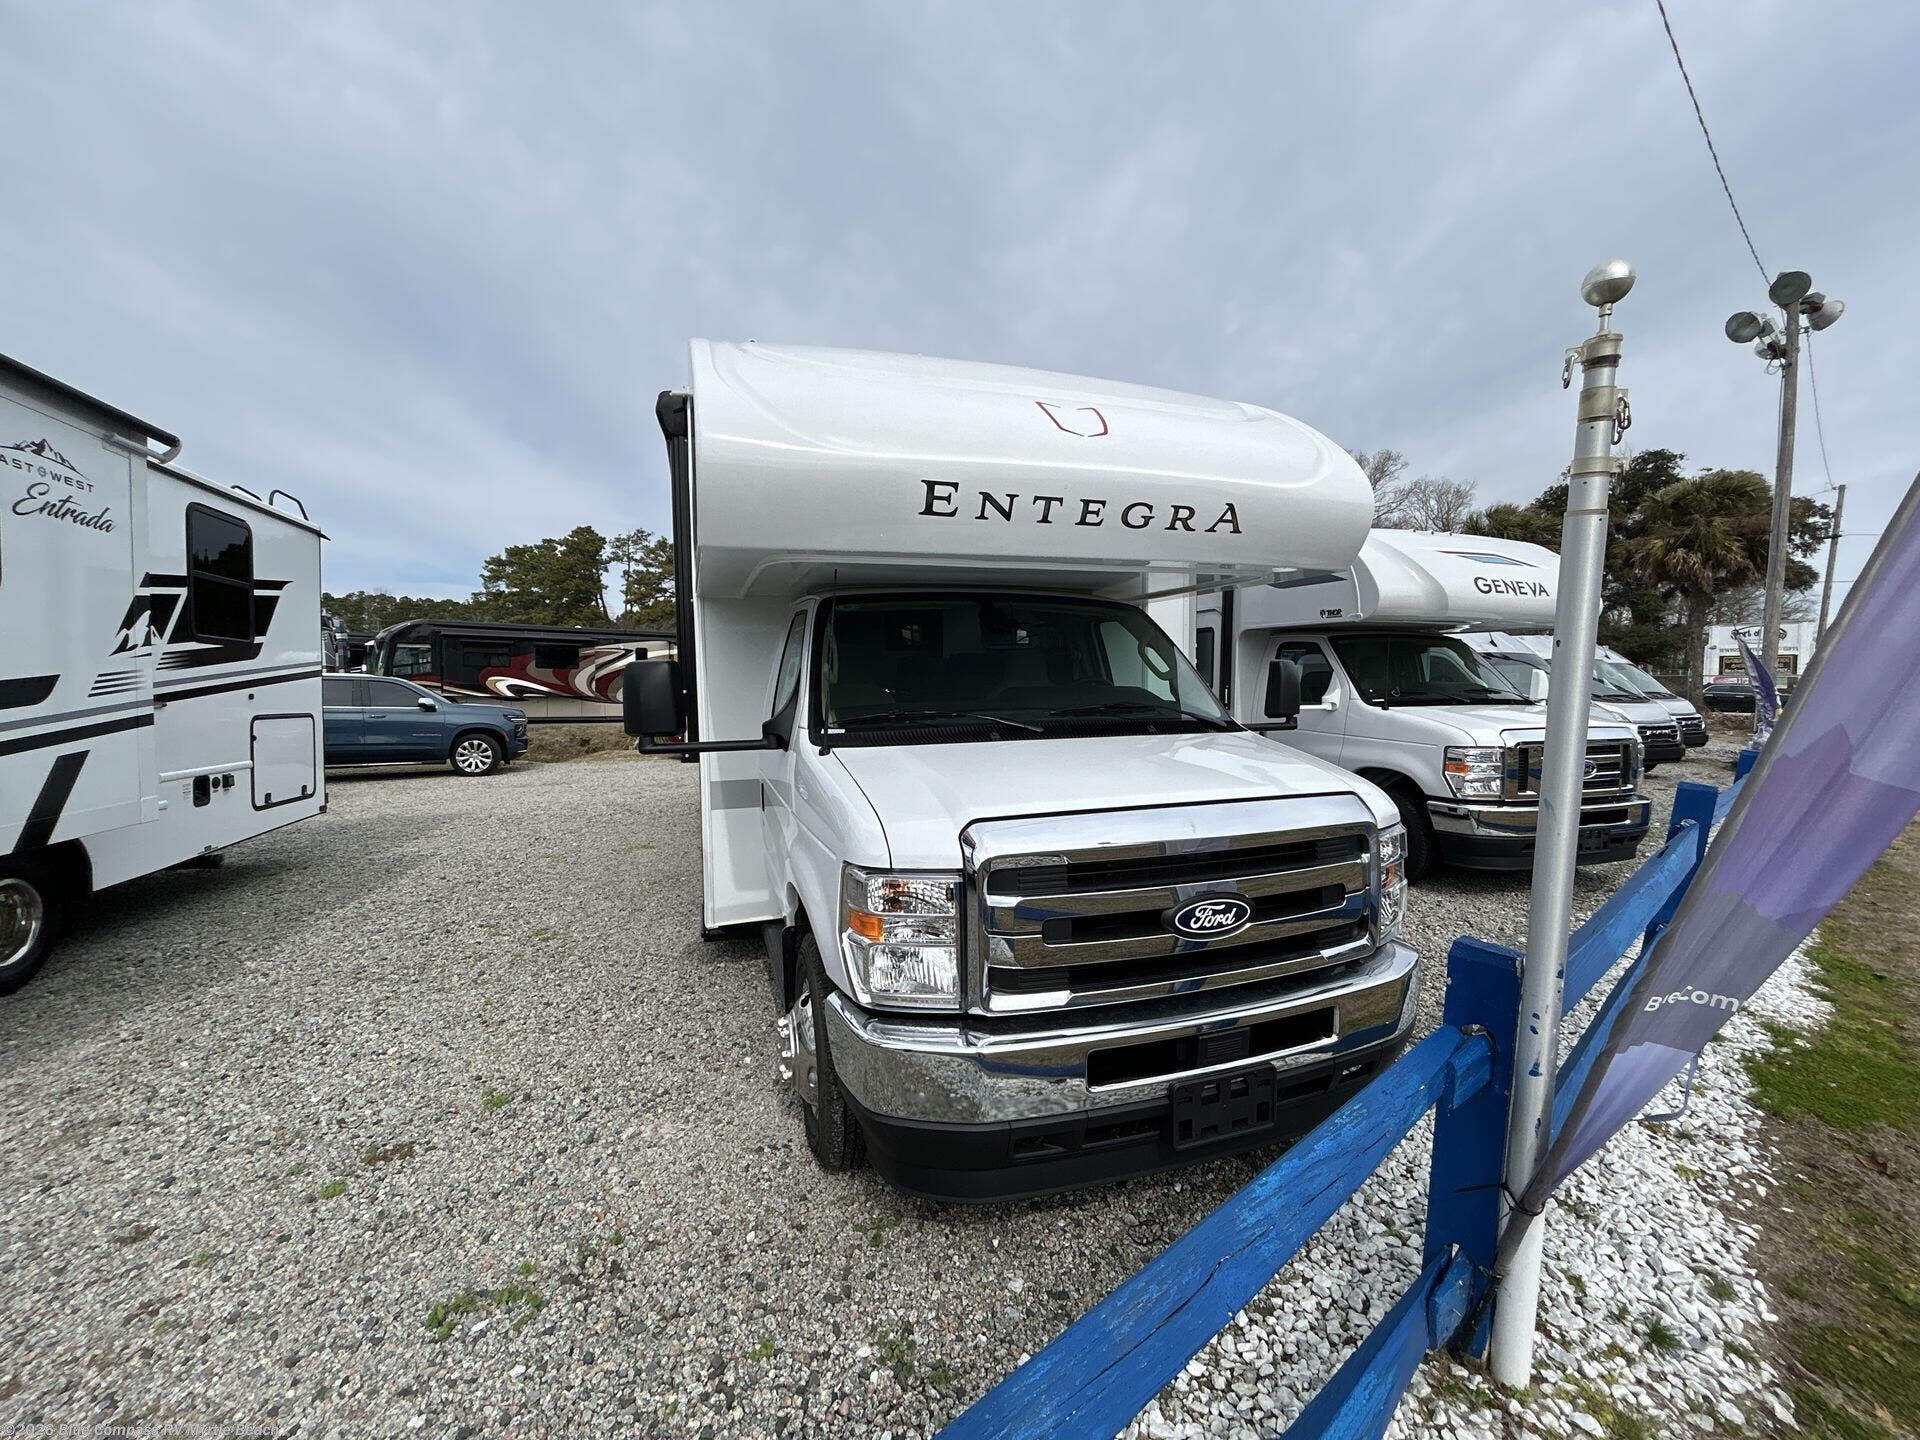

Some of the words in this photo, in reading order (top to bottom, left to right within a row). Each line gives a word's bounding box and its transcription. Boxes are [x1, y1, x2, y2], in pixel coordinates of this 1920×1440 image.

[49, 470, 94, 493] WEST
[12, 482, 117, 533] Entrada
[918, 479, 1242, 534] ENTEGRA
[1473, 576, 1550, 598] GENEVA
[1190, 904, 1237, 929] Ford
